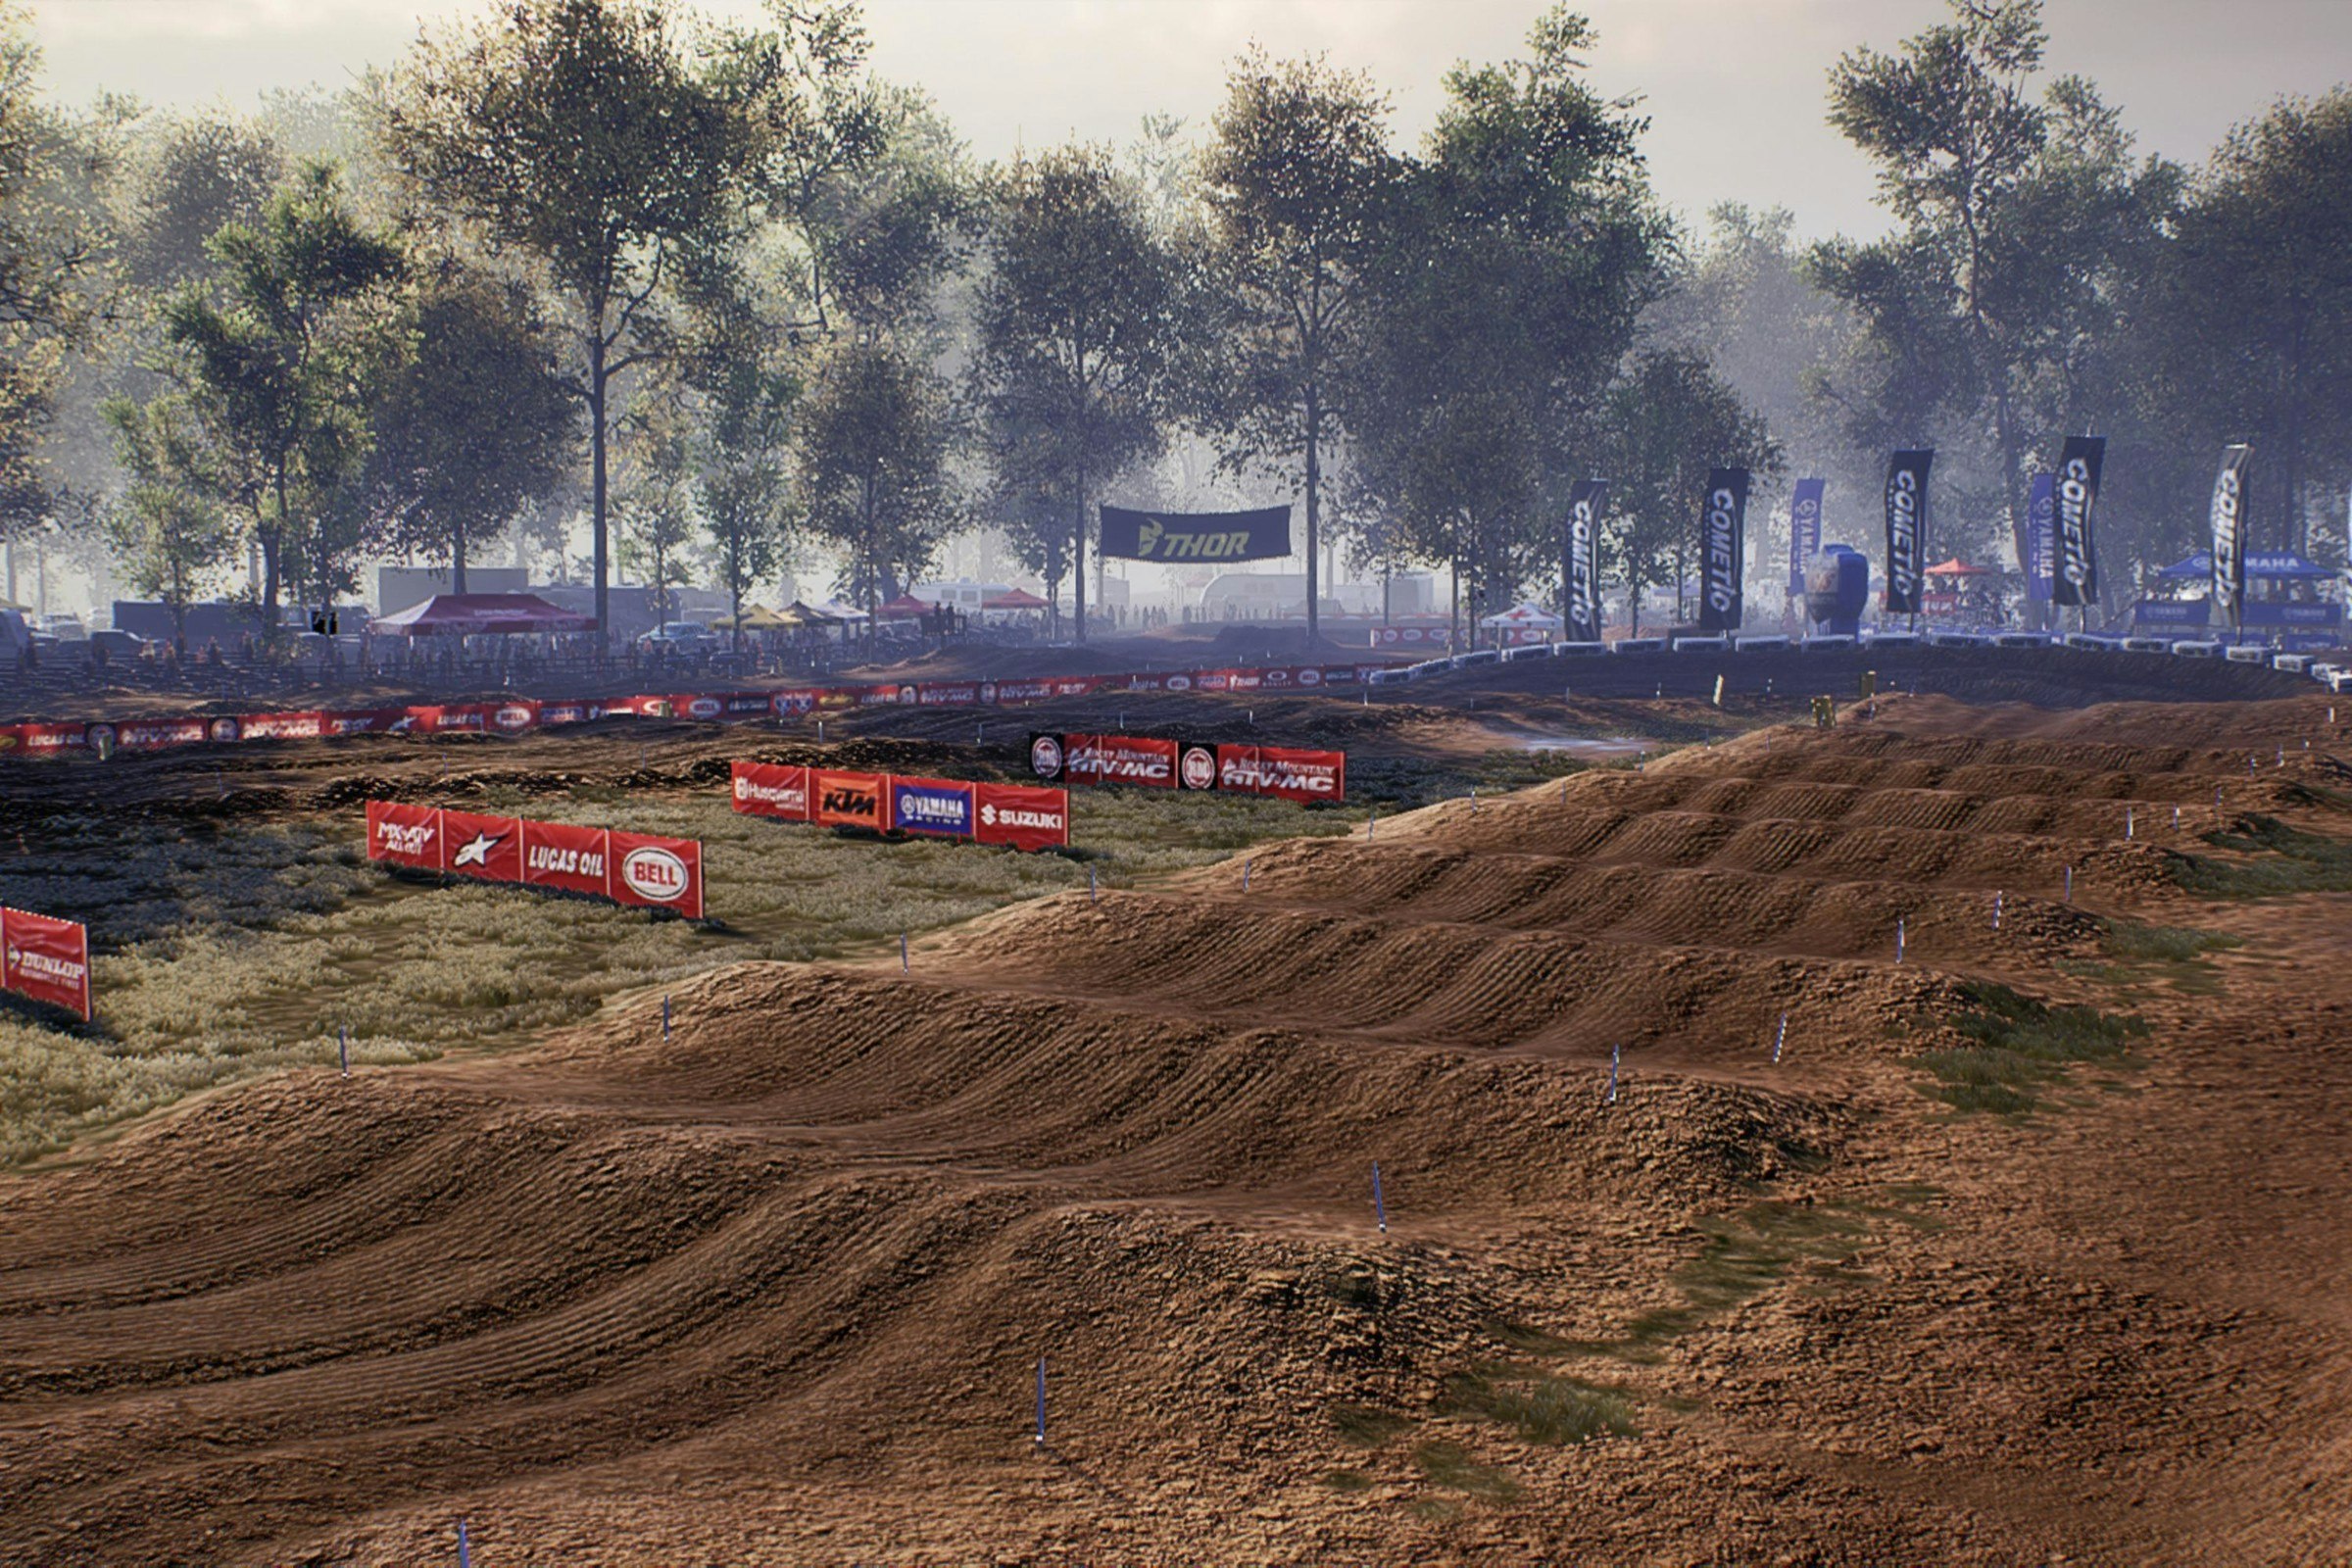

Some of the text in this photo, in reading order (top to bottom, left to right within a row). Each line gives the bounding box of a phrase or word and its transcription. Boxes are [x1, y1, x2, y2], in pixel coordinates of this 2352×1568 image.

[1892, 469, 1918, 596] COMETIC
[2061, 458, 2090, 586] COMETIC
[1163, 532, 1250, 558] THOR
[1708, 489, 1737, 612] COMETIC
[2037, 517, 2054, 578] YAMAHA
[1571, 500, 1594, 625] COMETIC
[2244, 557, 2299, 568] MAHA
[27, 734, 65, 747] LUCAS
[822, 787, 876, 816] KTM
[914, 796, 964, 819] YAMAHA
[999, 809, 1062, 830] SUZUKI
[528, 846, 605, 877] LUCAS OIL
[634, 861, 678, 887] BELL
[22, 951, 84, 979] DUNLOP
